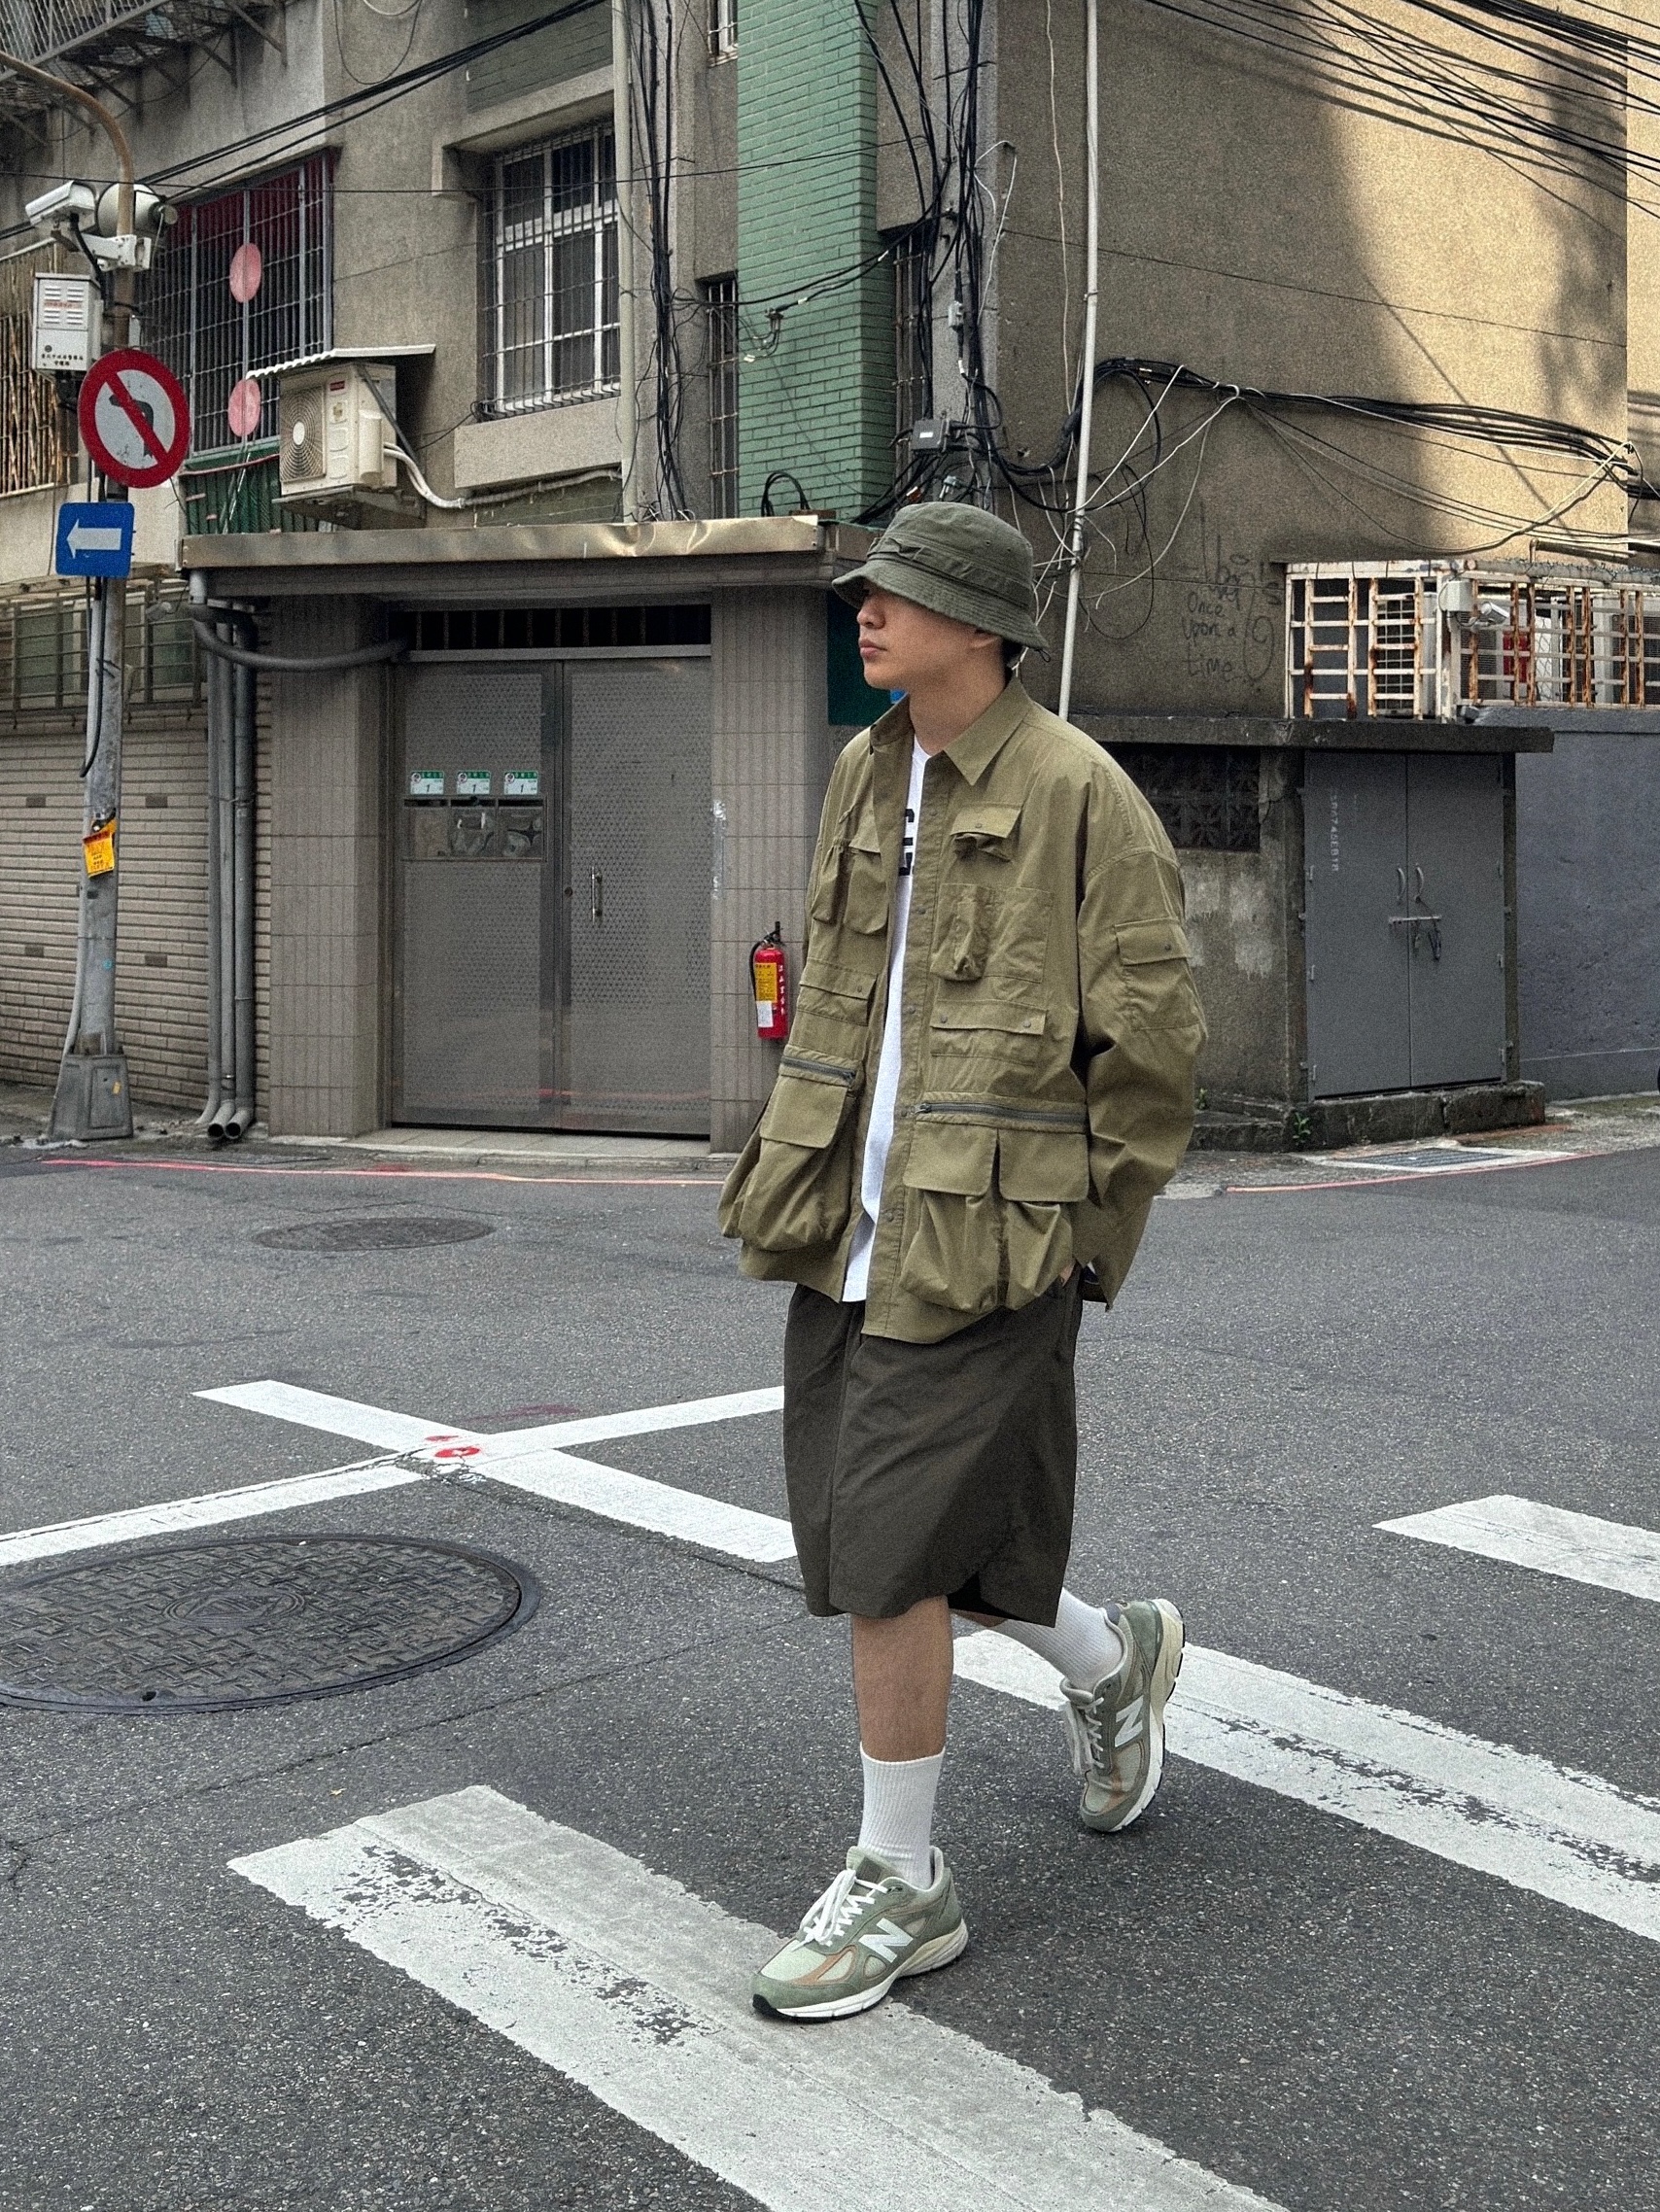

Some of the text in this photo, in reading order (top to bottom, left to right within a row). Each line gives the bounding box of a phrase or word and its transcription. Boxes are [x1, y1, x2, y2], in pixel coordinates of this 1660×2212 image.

[1187, 591, 1226, 617] Once
[1114, 1695, 1144, 1747] N
[858, 1918, 914, 1963] N
